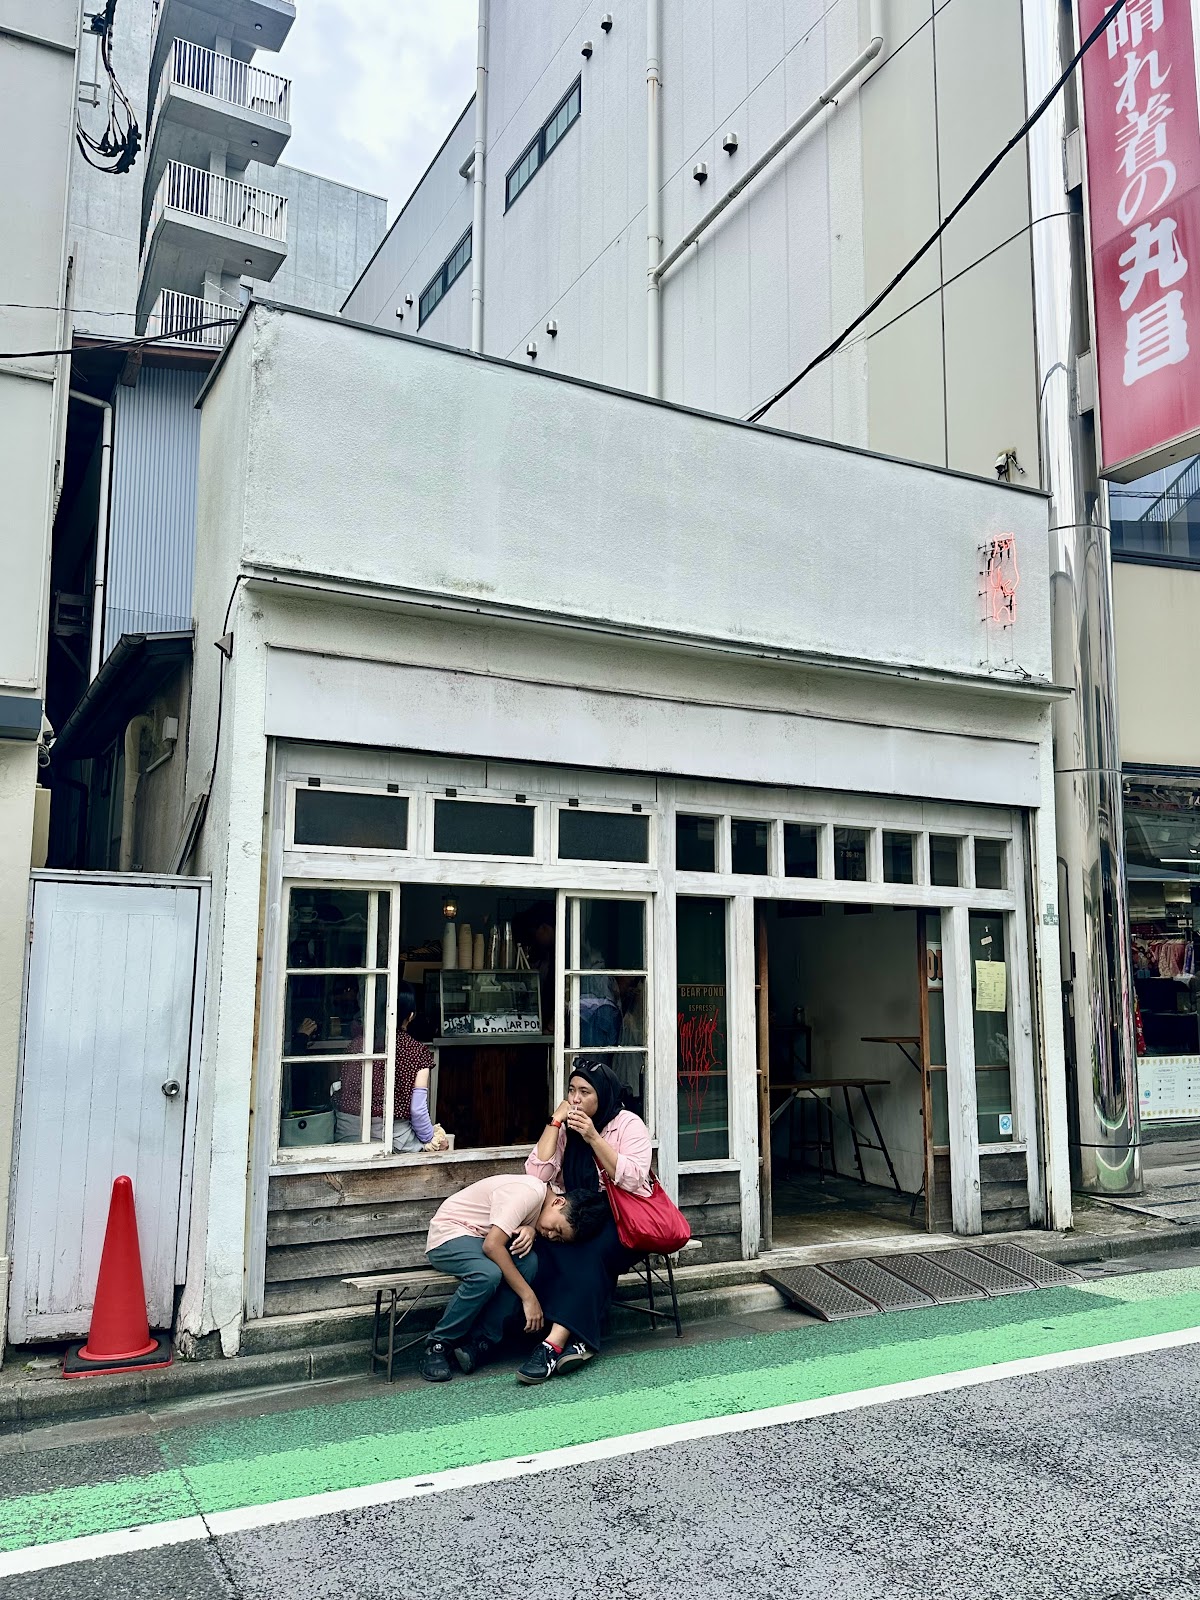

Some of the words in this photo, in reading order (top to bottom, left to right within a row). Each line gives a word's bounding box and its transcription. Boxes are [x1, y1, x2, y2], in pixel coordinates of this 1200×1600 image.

[681, 987, 701, 997] BEAR
[703, 987, 724, 997] POND
[507, 1020, 522, 1029] AR
